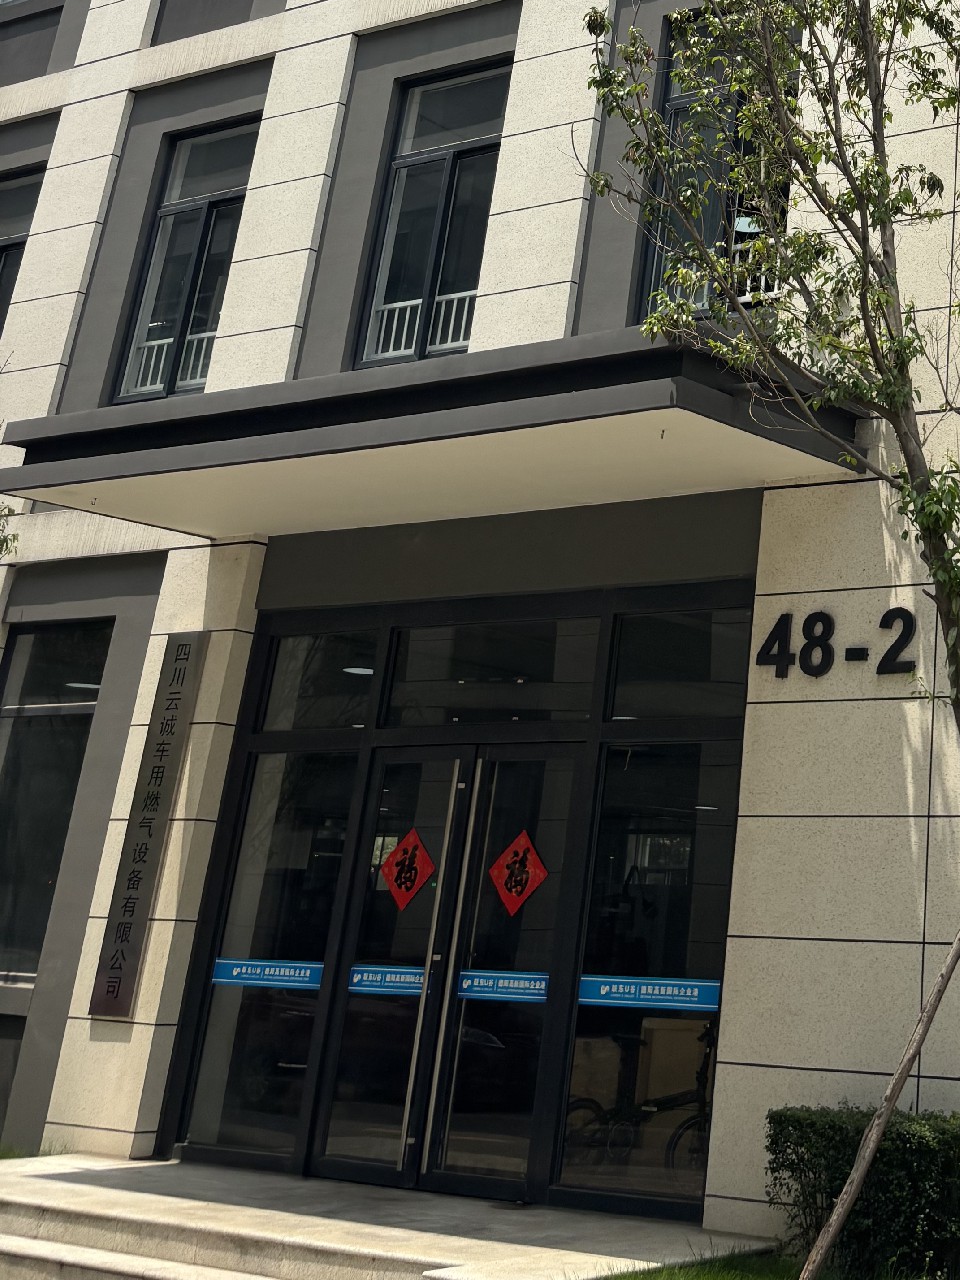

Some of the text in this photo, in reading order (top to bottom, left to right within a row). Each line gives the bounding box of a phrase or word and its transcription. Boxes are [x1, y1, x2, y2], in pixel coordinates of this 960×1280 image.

[756, 607, 917, 679] 48-2
[105, 642, 192, 1001] 四川云诚车用燃气设备有限公司
